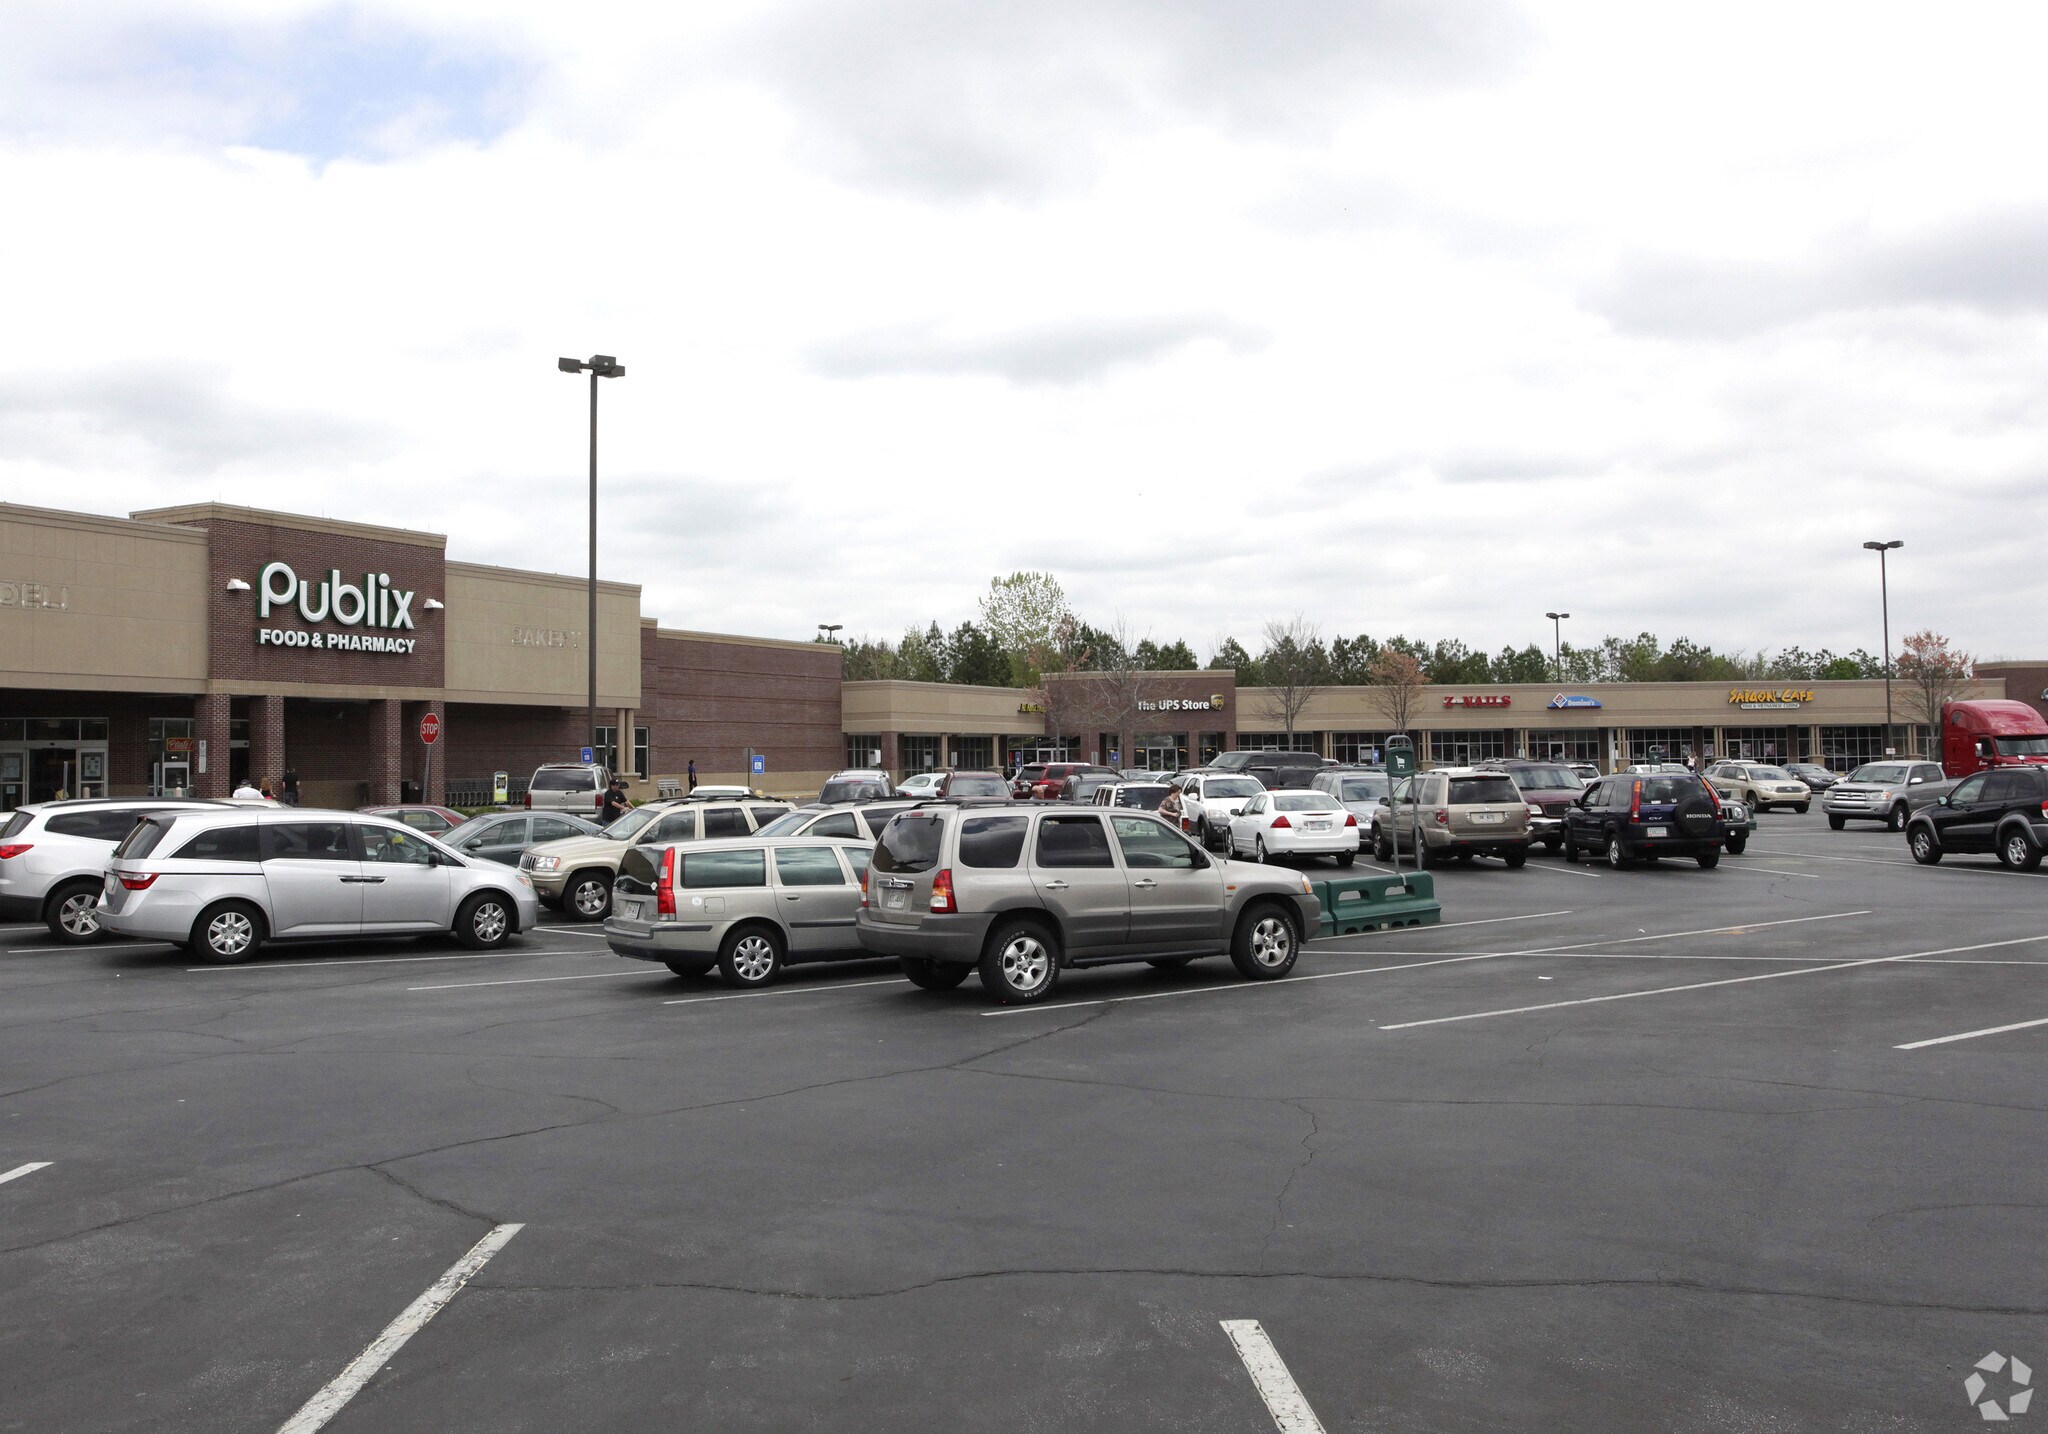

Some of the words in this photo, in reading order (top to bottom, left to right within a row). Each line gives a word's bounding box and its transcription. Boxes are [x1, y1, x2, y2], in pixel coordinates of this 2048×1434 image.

[257, 562, 415, 630] Publix
[258, 628, 309, 648] FOOD
[311, 632, 324, 649] &
[327, 633, 416, 654] PHARMACY
[1138, 701, 1156, 711] The
[1158, 699, 1180, 711] UPS
[1182, 699, 1210, 711] Store
[1462, 695, 1512, 709] NAILS
[1568, 699, 1596, 707] Domino's
[422, 723, 438, 735] STOP
